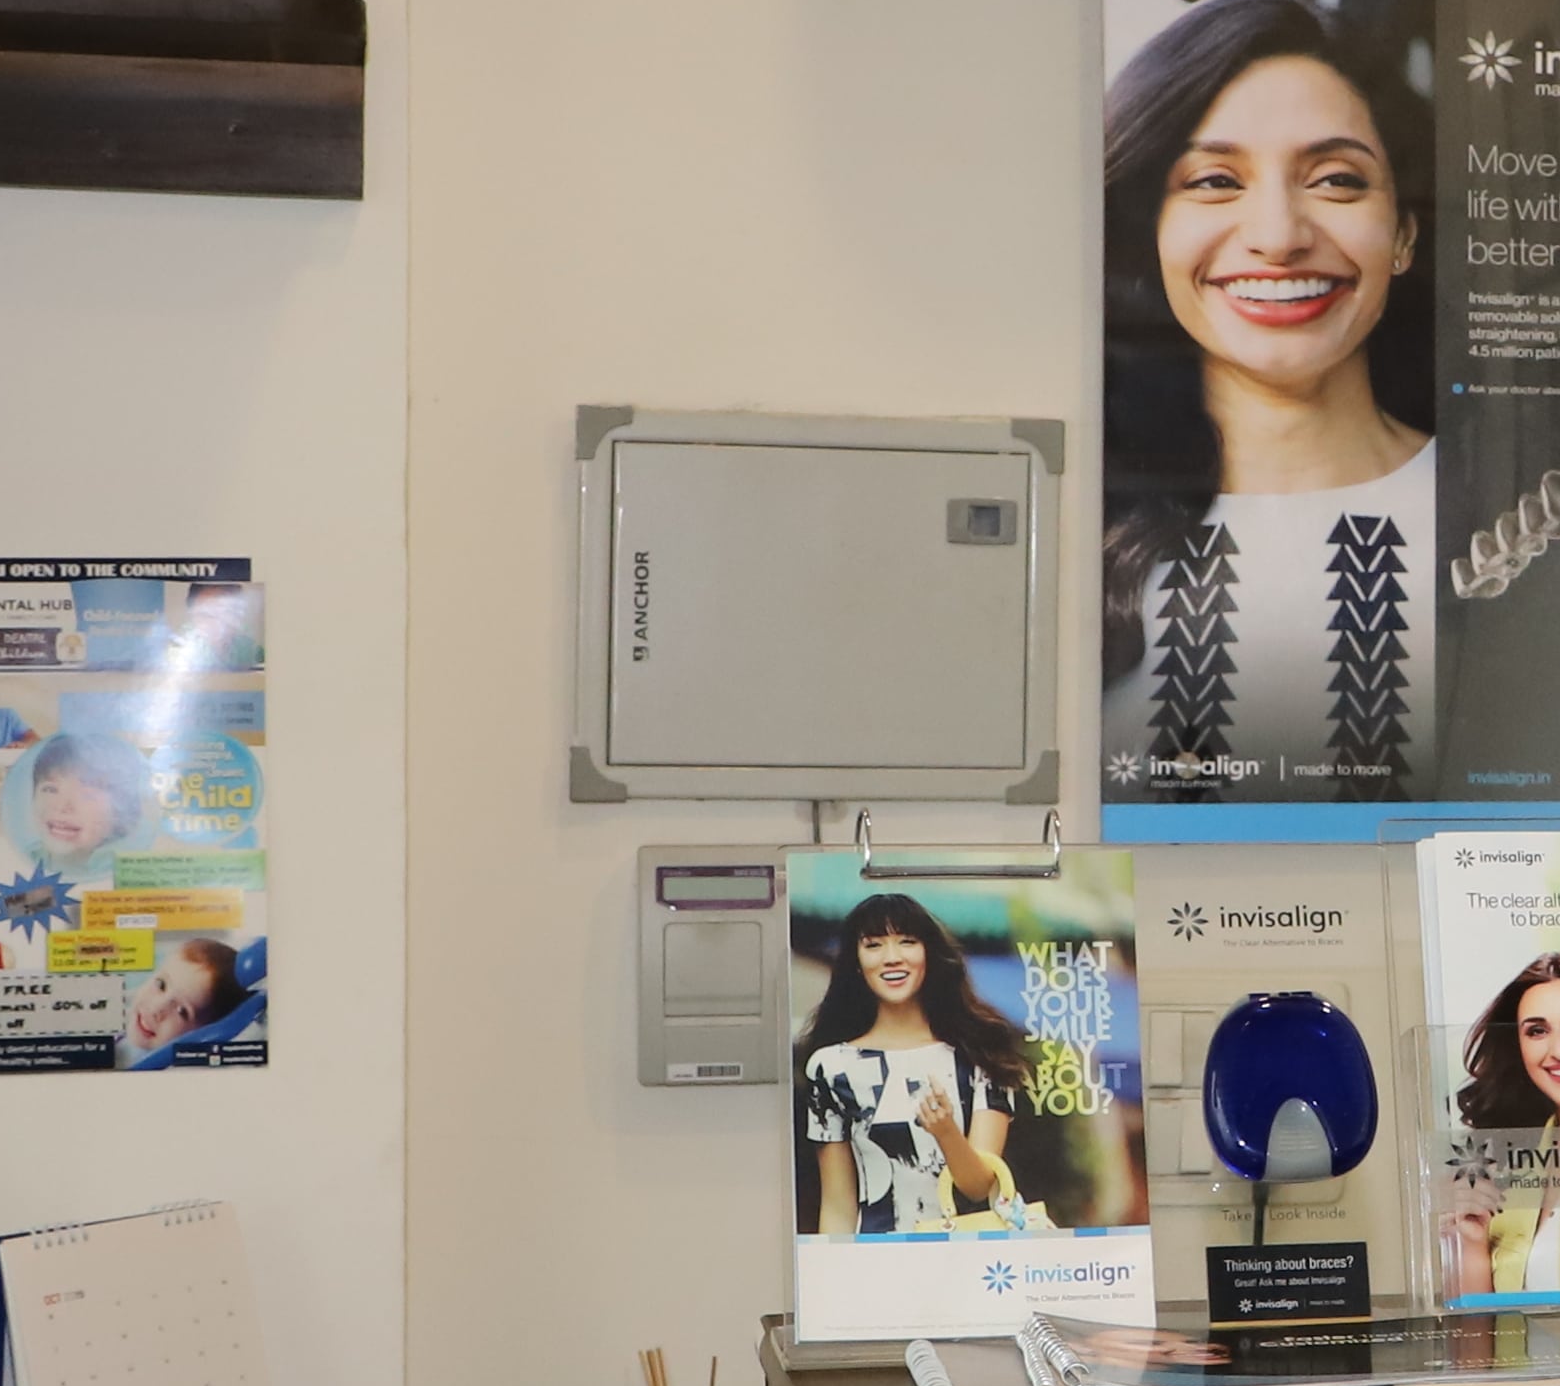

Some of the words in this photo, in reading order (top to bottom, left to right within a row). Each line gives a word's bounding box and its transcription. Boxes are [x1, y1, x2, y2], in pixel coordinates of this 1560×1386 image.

[1468, 144, 1558, 177] Move
[1468, 189, 1509, 221] life
[1468, 234, 1560, 266] better
[1468, 310, 1538, 325] removable
[1468, 326, 1558, 345] straightening,
[1468, 347, 1490, 359] 4.5
[1491, 346, 1534, 360] million
[9, 563, 55, 578] OPEN
[59, 563, 82, 577] TO
[85, 563, 119, 577] THE
[124, 563, 218, 578] COMMUNITY
[40, 599, 73, 611] HUB
[634, 551, 649, 641] ANCHOR
[1150, 755, 1260, 780] inalign
[1294, 764, 1333, 777] made
[1337, 763, 1351, 776] to
[1353, 765, 1392, 778] move
[157, 784, 253, 808] Child
[169, 813, 241, 833] Time
[1479, 851, 1542, 866] invisalign
[1467, 892, 1498, 909] The
[1501, 893, 1540, 909] clear
[1220, 905, 1343, 933] invisalign
[1510, 912, 1527, 927] to
[1017, 941, 1113, 972] WHAT
[1025, 966, 1108, 993] DOES
[3, 984, 52, 995] FREE
[89, 1000, 108, 1011] off
[1020, 989, 1115, 1016] YOUR
[6, 1019, 26, 1029] off
[1024, 1014, 1112, 1042] SMILE
[1042, 1040, 1096, 1066] SAY
[1026, 1087, 1114, 1116] YOU?
[1510, 1173, 1549, 1189] made
[1223, 1209, 1252, 1222] Take
[1269, 1207, 1301, 1221] Look
[1307, 1206, 1346, 1219] Inside
[1224, 1258, 1272, 1274] Thinking
[1275, 1256, 1307, 1271] about
[1309, 1255, 1354, 1270] braces?
[1025, 1262, 1131, 1287] invisalign
[1234, 1278, 1257, 1288] Great!
[1258, 1277, 1273, 1287] Ask
[1275, 1278, 1287, 1286] me
[1289, 1277, 1310, 1286] about
[1311, 1276, 1346, 1287] Invisalign
[1255, 1298, 1299, 1311] invisalign
